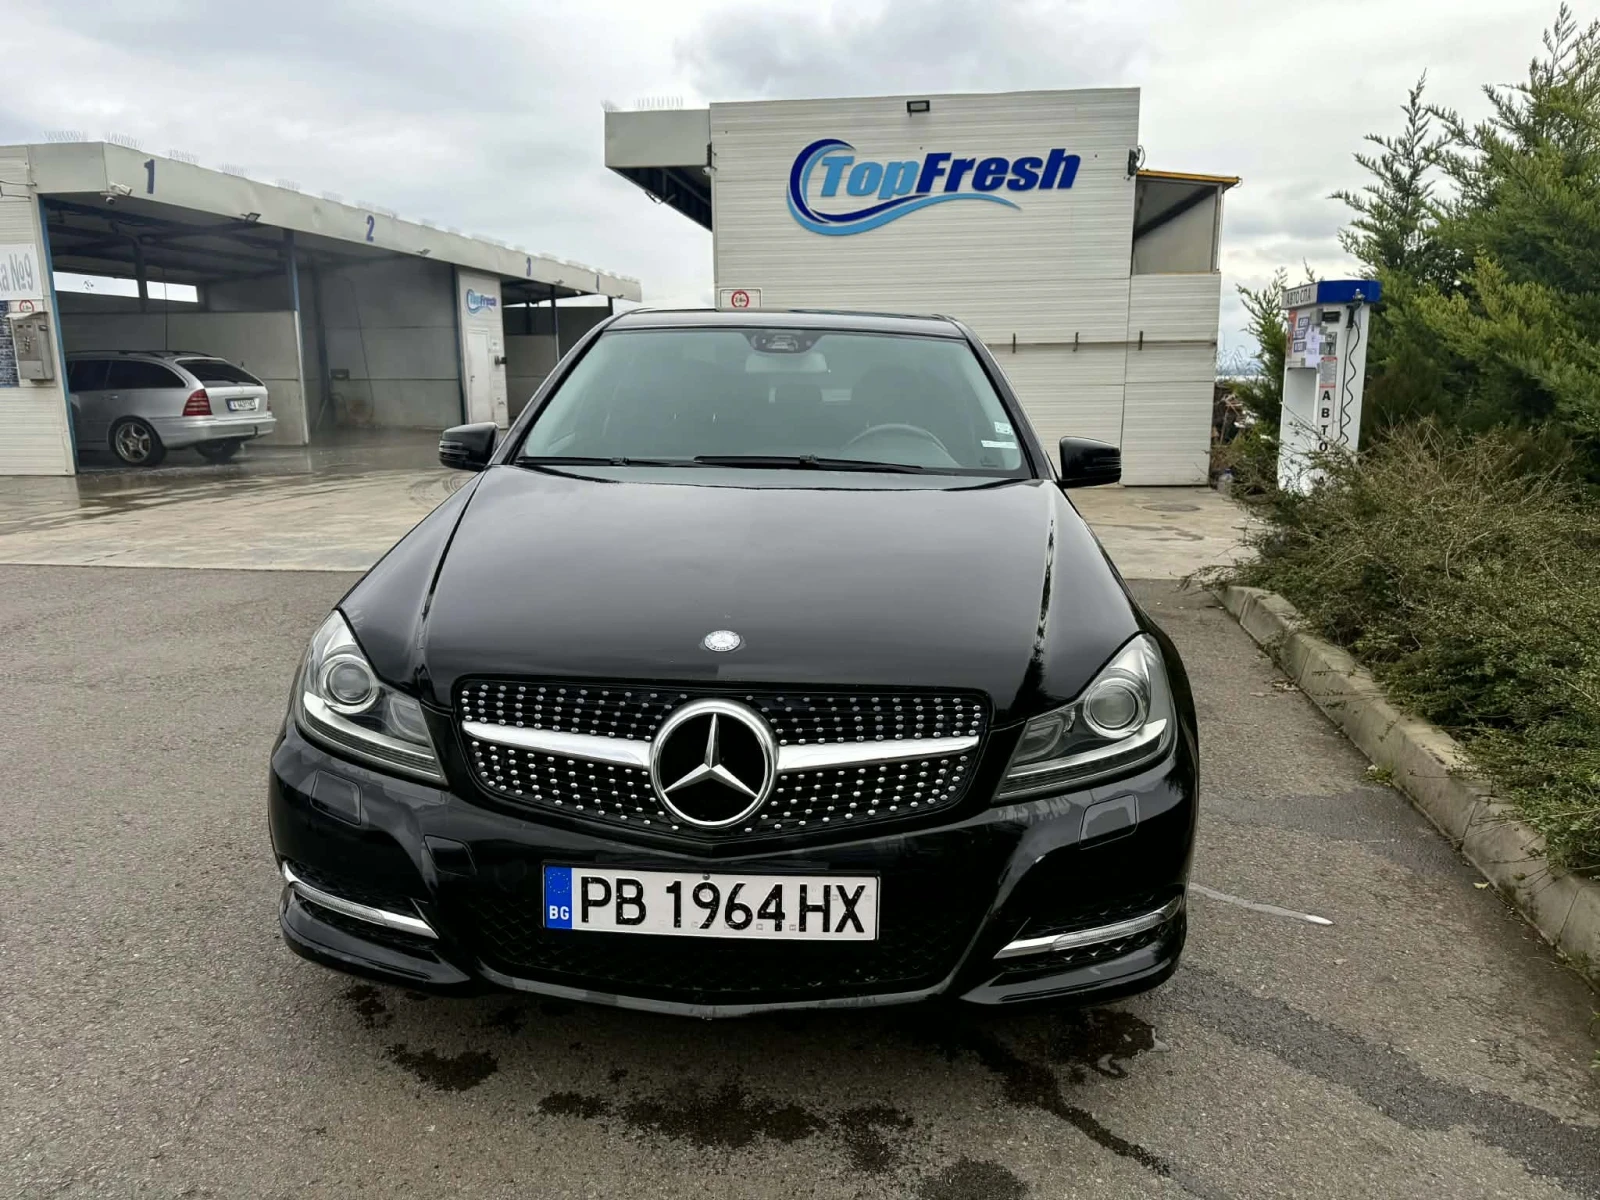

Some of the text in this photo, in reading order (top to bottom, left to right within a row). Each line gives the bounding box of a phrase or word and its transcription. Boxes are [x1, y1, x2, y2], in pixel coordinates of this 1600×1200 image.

[143, 159, 155, 194] 1
[820, 148, 1082, 200] TopFresh
[365, 215, 375, 242] 2
[526, 256, 532, 277] 3
[548, 904, 570, 920] BG
[580, 875, 867, 934] PB 1964 HX
